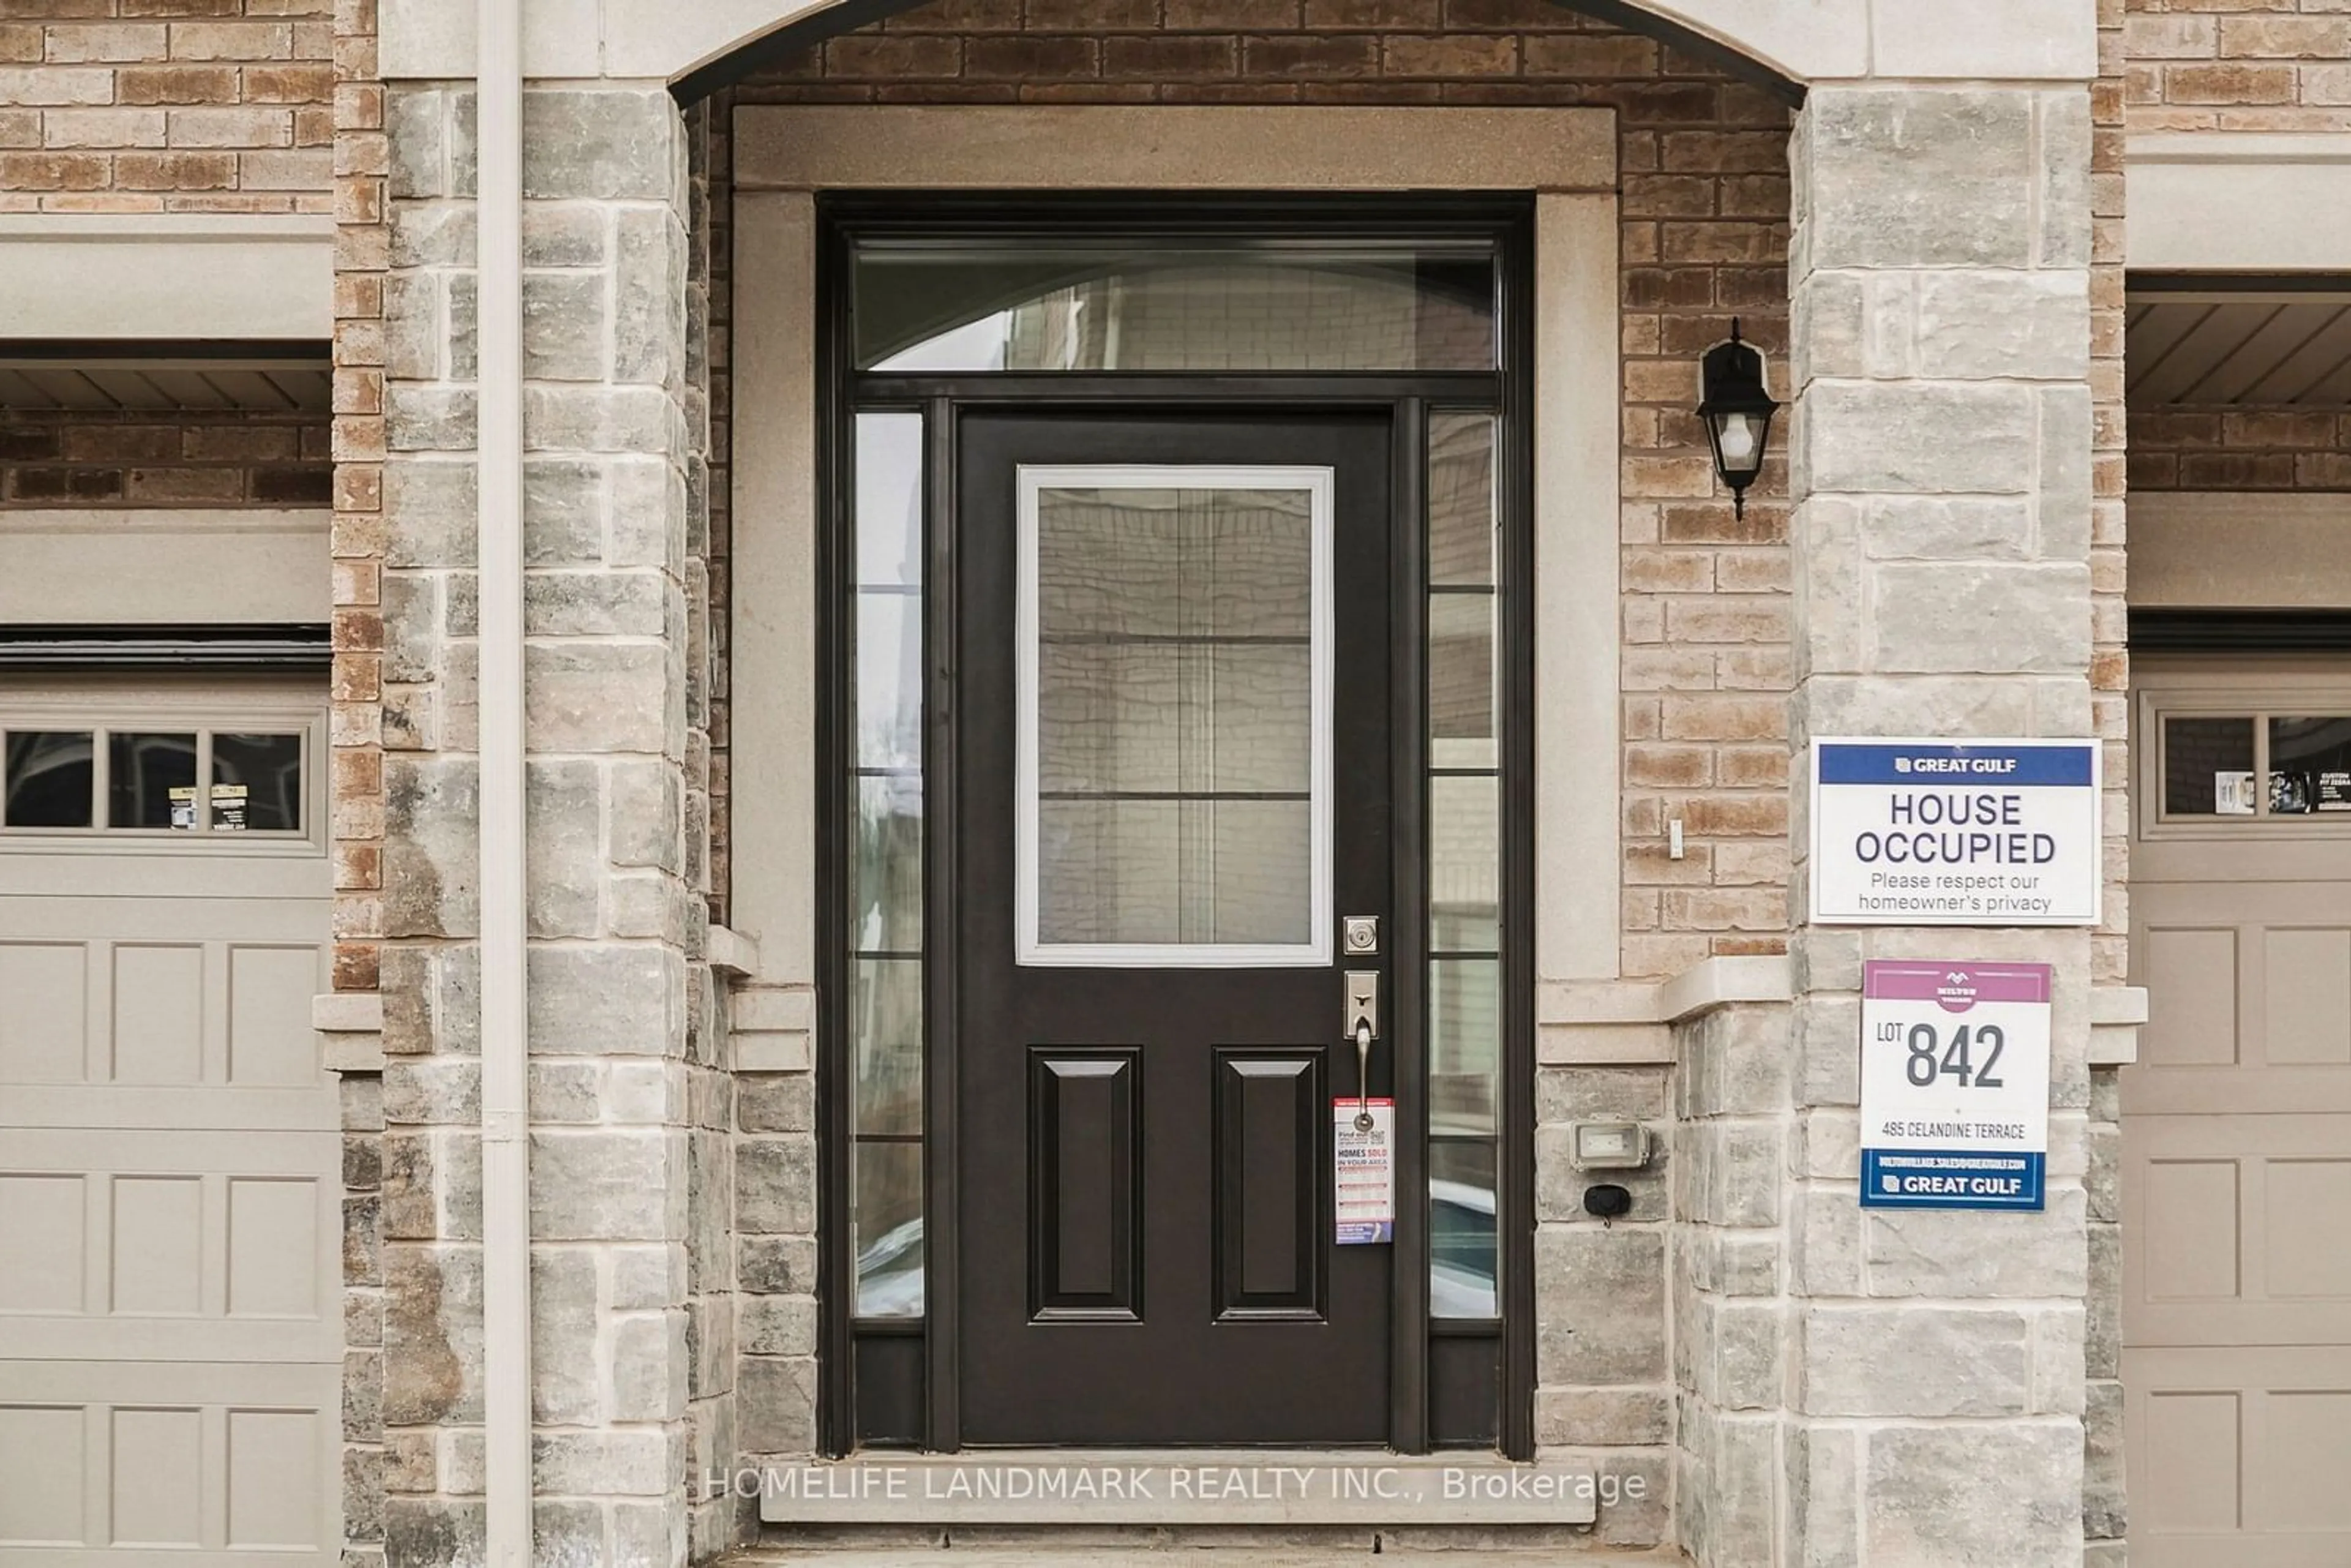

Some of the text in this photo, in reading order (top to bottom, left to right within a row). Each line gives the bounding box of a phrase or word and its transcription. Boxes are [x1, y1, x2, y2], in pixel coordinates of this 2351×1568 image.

[1914, 758, 2017, 773] GREAT GULF
[1891, 794, 2022, 825] HOUSE
[1855, 832, 2055, 864] OCCUPIED
[1871, 872, 2039, 896] Please respect our
[1859, 894, 2052, 914] homeowner's privacy
[1877, 1022, 2005, 1088] LOT 842
[1907, 1122, 1971, 1138] CELANDINE
[1974, 1123, 2025, 1139] TERRACE
[1338, 1149, 1387, 1157] HOMES SOLD
[1903, 1176, 2022, 1194] GREAT GULF
